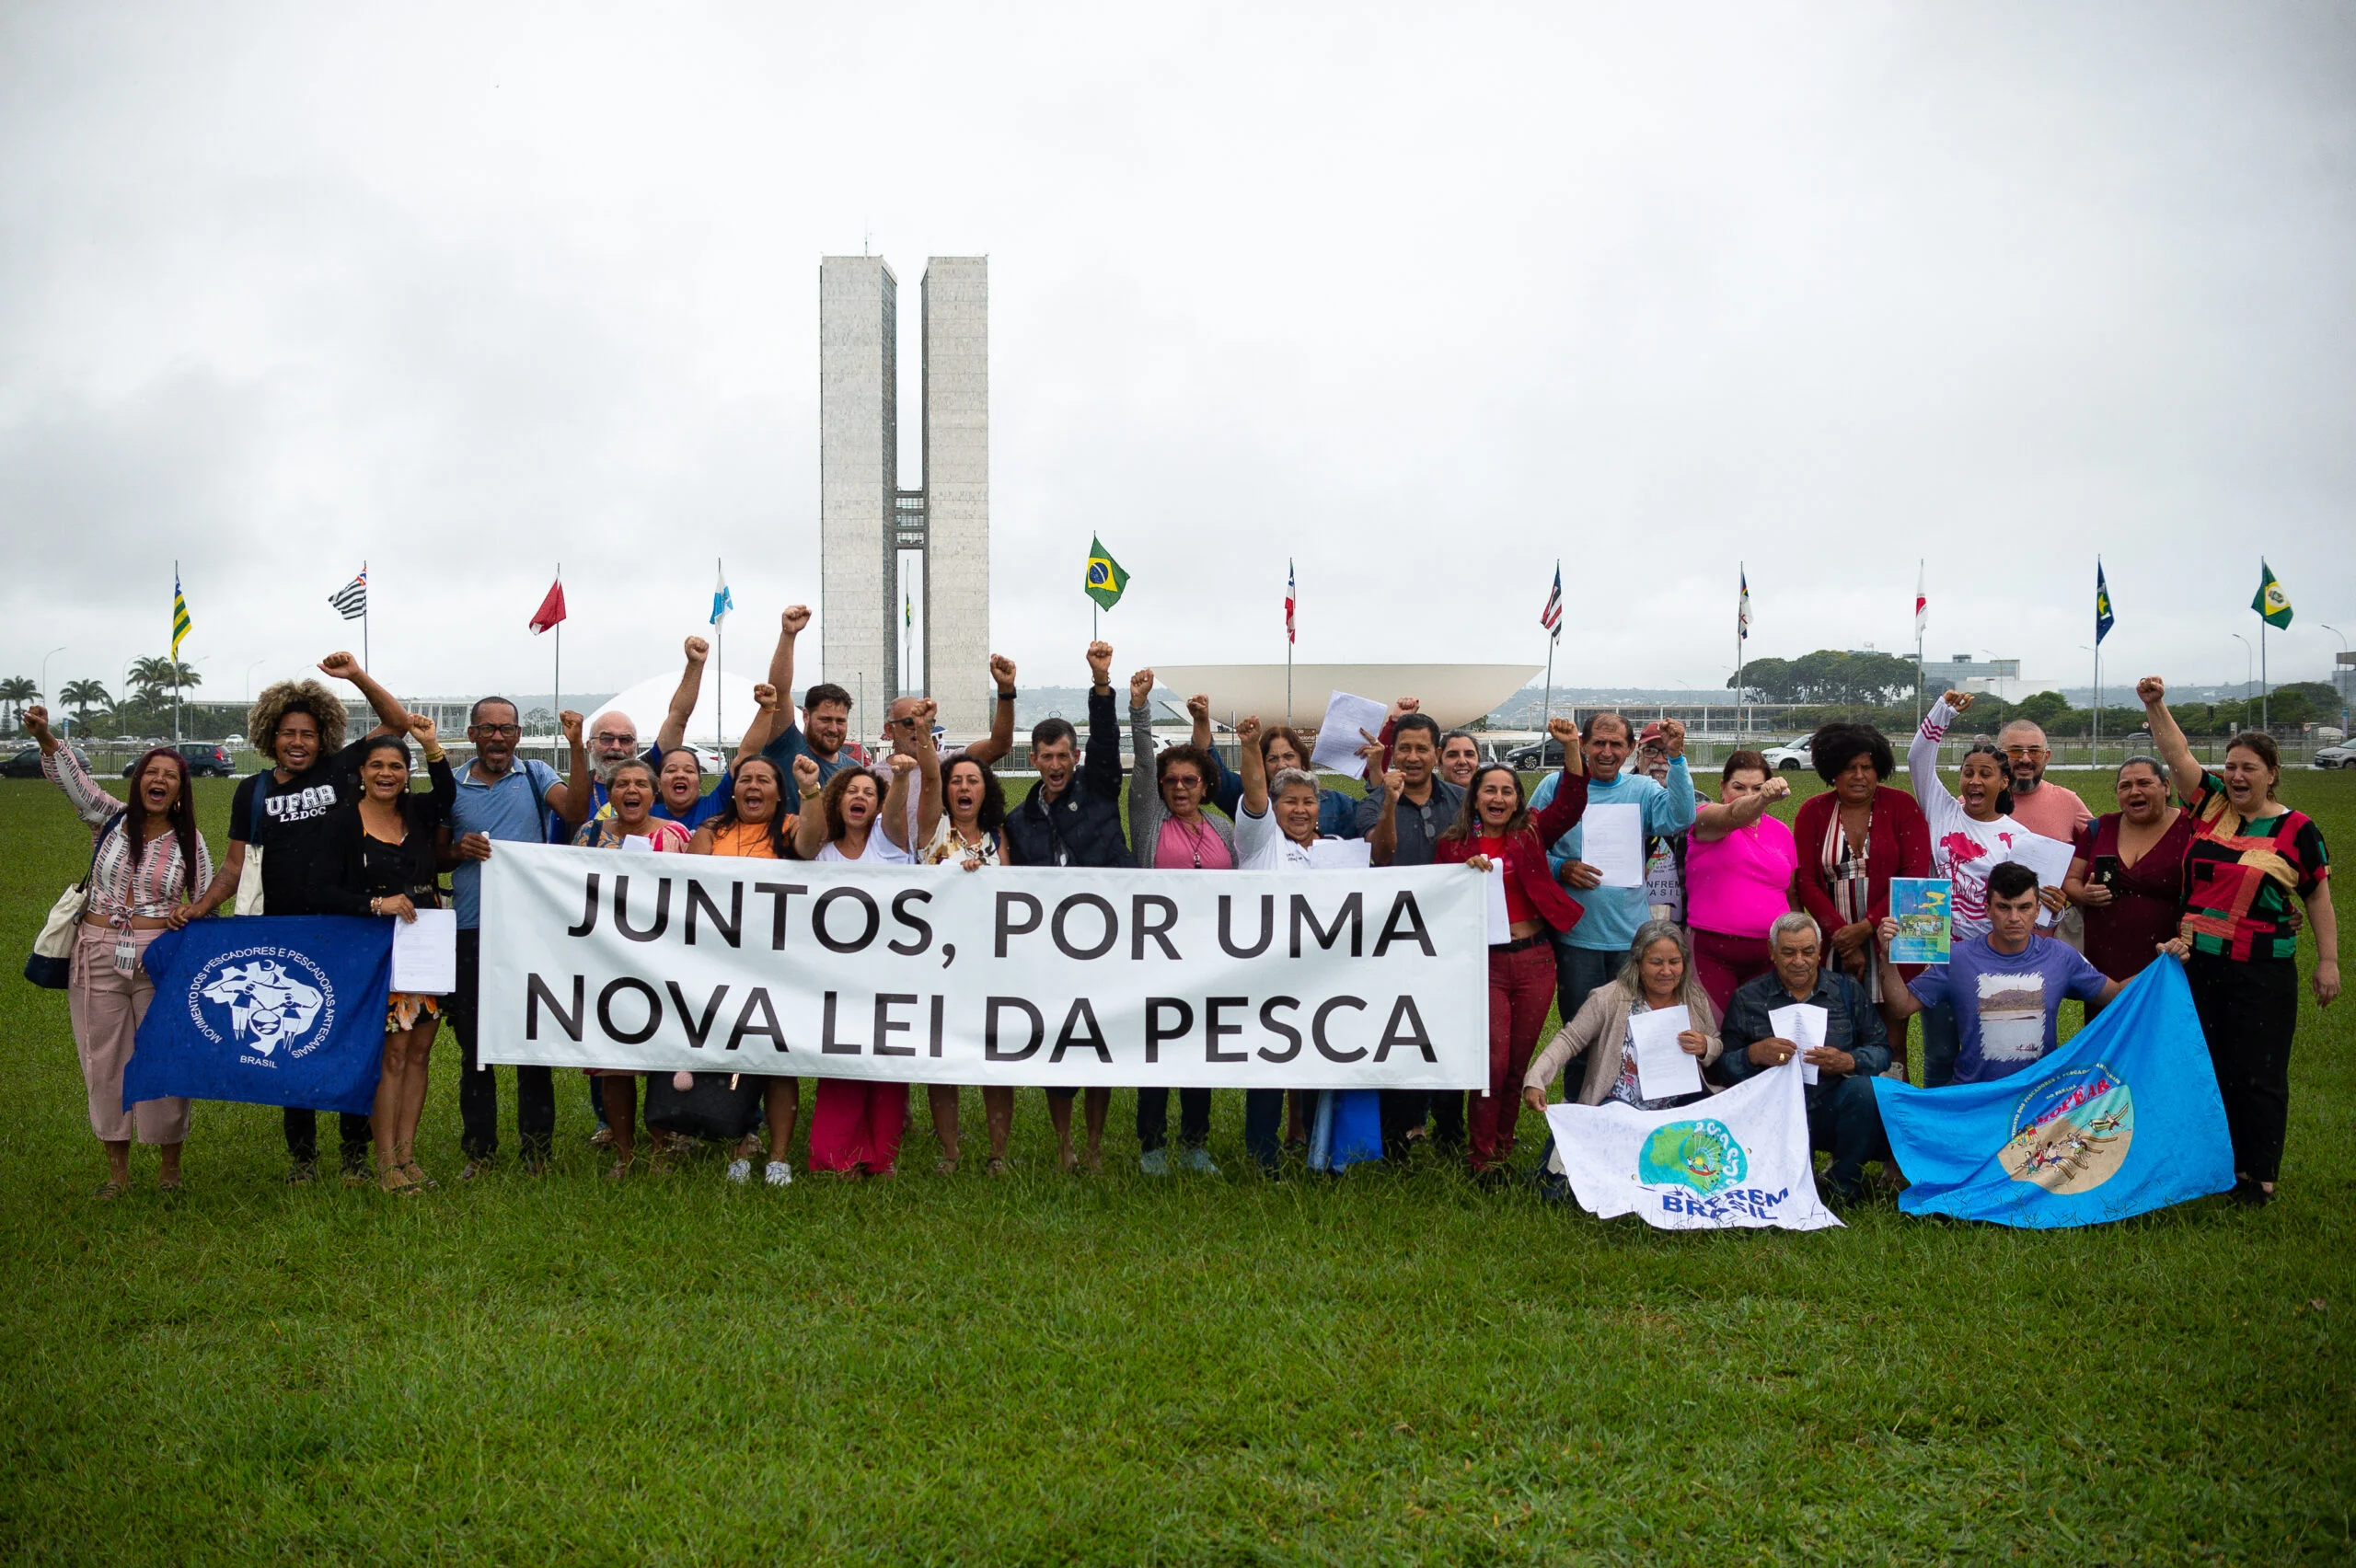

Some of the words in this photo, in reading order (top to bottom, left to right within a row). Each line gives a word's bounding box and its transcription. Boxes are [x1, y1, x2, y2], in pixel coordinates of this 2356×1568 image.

[280, 806, 326, 822] LEDOC
[567, 872, 956, 969] JUNTOS,
[994, 891, 1183, 961] POR
[1218, 890, 1438, 959] UMA
[203, 946, 276, 974] PESCADORES
[277, 948, 287, 958] E
[191, 972, 207, 991] DOS
[286, 950, 336, 1008] PESCADORAS
[189, 991, 223, 1044] MOVIMENTO
[291, 1009, 335, 1059] ARTESANAIS
[525, 973, 790, 1053] NOVA
[821, 990, 944, 1057] LEI
[985, 996, 1113, 1063] DA
[1145, 995, 1438, 1064] PESCA
[240, 1055, 277, 1068] BRASIL
